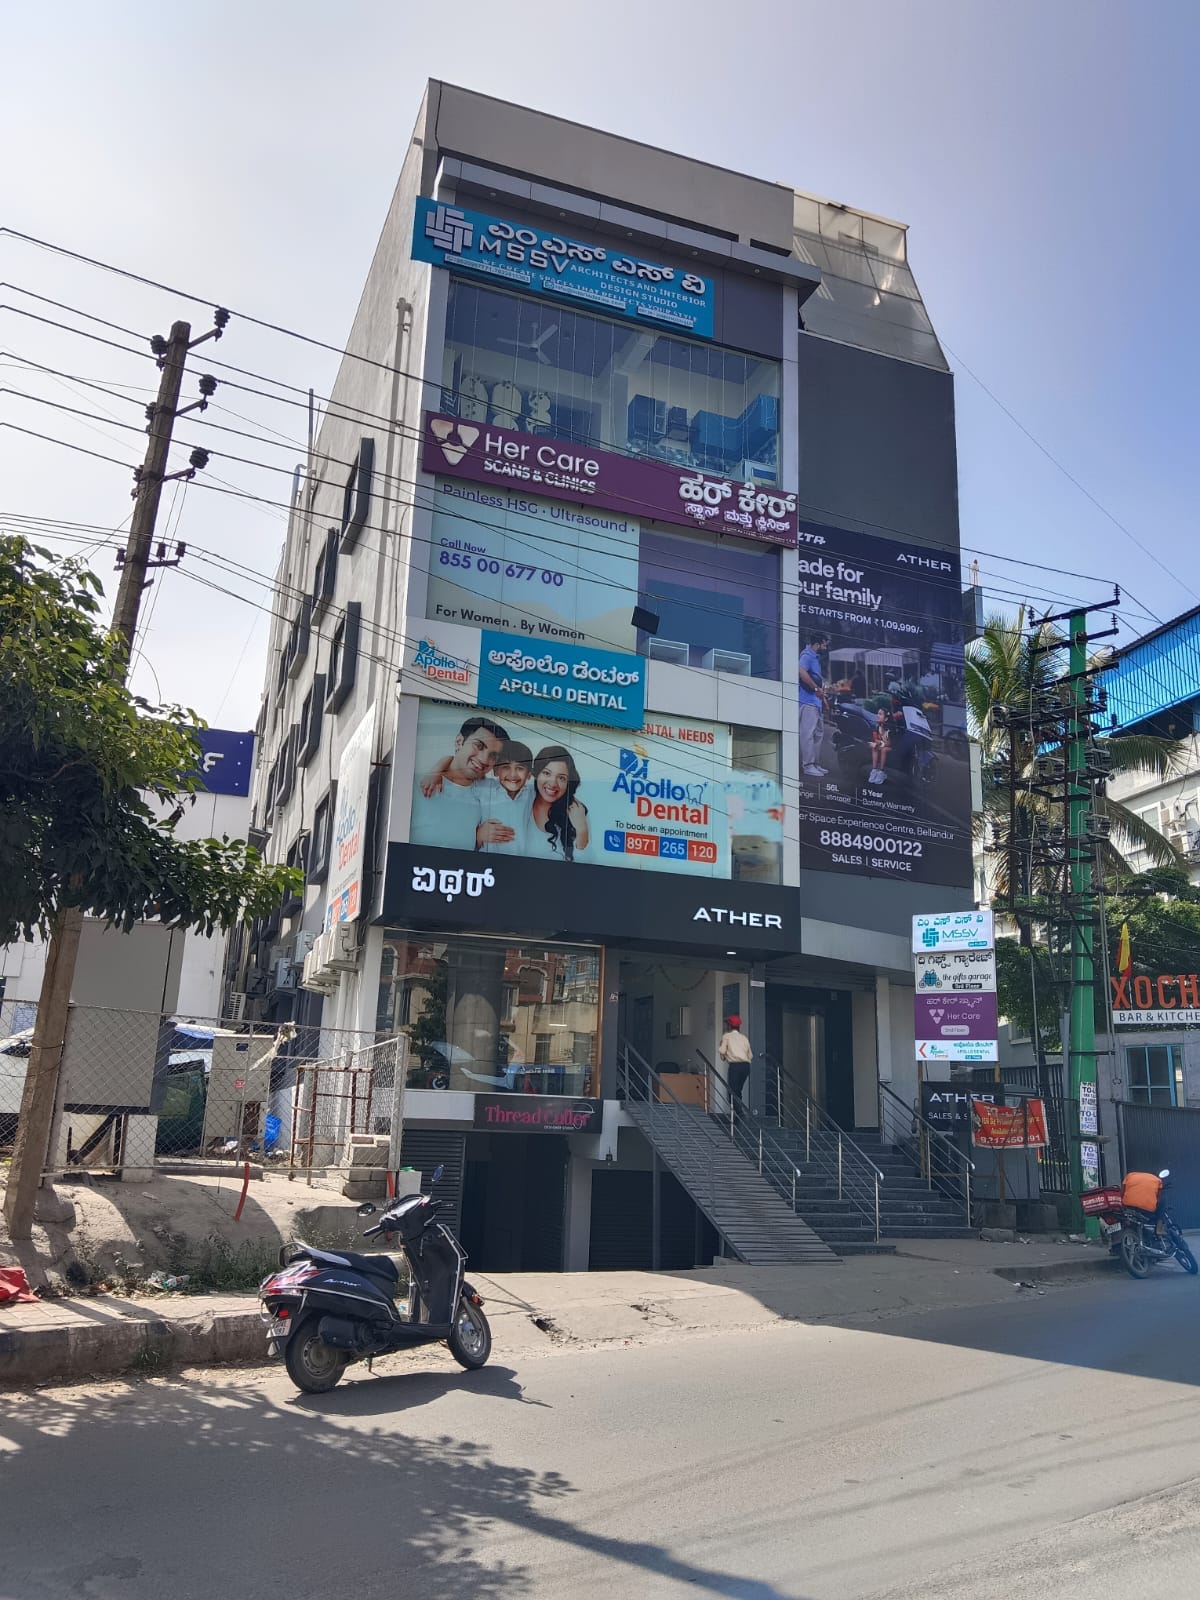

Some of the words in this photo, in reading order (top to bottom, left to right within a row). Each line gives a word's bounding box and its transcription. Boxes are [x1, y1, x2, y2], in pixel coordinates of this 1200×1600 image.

[479, 234, 570, 273] MSSV
[570, 264, 635, 288] ARCHITECTS
[636, 282, 657, 293] AND
[660, 288, 706, 308] INTERIOR
[600, 282, 639, 298] DESIGN
[641, 293, 678, 309] STUDIO
[485, 432, 529, 461] Her
[536, 445, 600, 477] Care
[484, 457, 530, 481] SCANS
[533, 470, 543, 482] &
[545, 471, 597, 495] CLINICS
[443, 483, 503, 508] Painless
[507, 498, 538, 515] HSG
[551, 506, 628, 534] Ultrasound
[440, 537, 461, 550] Call
[463, 541, 487, 554] Now
[439, 550, 472, 570] 855
[476, 558, 500, 575] 00
[505, 564, 536, 581] 677
[541, 570, 564, 587] 00
[837, 562, 864, 584] for
[896, 553, 952, 572] ATHER
[825, 580, 882, 612] family
[436, 604, 457, 619] For
[460, 608, 510, 629] Women
[520, 620, 536, 634] By
[538, 622, 586, 641] Women
[808, 605, 843, 620] STARTS
[845, 612, 871, 625] FROM
[413, 652, 457, 674] Apollo
[427, 665, 470, 683] Dental
[499, 678, 563, 699] APOLLO
[566, 688, 628, 711] DENTAL
[678, 727, 715, 745] NEEDS
[612, 772, 686, 803] Apollo
[637, 796, 709, 825] Dental
[615, 820, 625, 829] To
[626, 821, 646, 833] book
[648, 825, 658, 833] an
[660, 826, 708, 840] appointment
[809, 813, 836, 826] Space
[837, 816, 885, 831] Experience
[917, 826, 954, 841] Bellandur
[627, 837, 657, 852] 8971
[662, 842, 686, 855] 265
[691, 844, 714, 859] 120
[819, 830, 923, 858] 8884900122
[831, 853, 862, 866] SALES
[871, 858, 912, 872] SERVICE
[692, 906, 783, 929] ATHER
[942, 928, 979, 939] MSSV
[1110, 974, 1200, 1008] XOCH
[947, 1012, 960, 1020] Her
[962, 1012, 981, 1021] Care
[1119, 1012, 1142, 1022] BAR
[1146, 1012, 1153, 1021] &
[1158, 1011, 1200, 1021] KITCHE
[929, 1092, 995, 1104] ATHER
[485, 1104, 540, 1124] Thread
[928, 1112, 952, 1120] SALES
[955, 1112, 961, 1120] &
